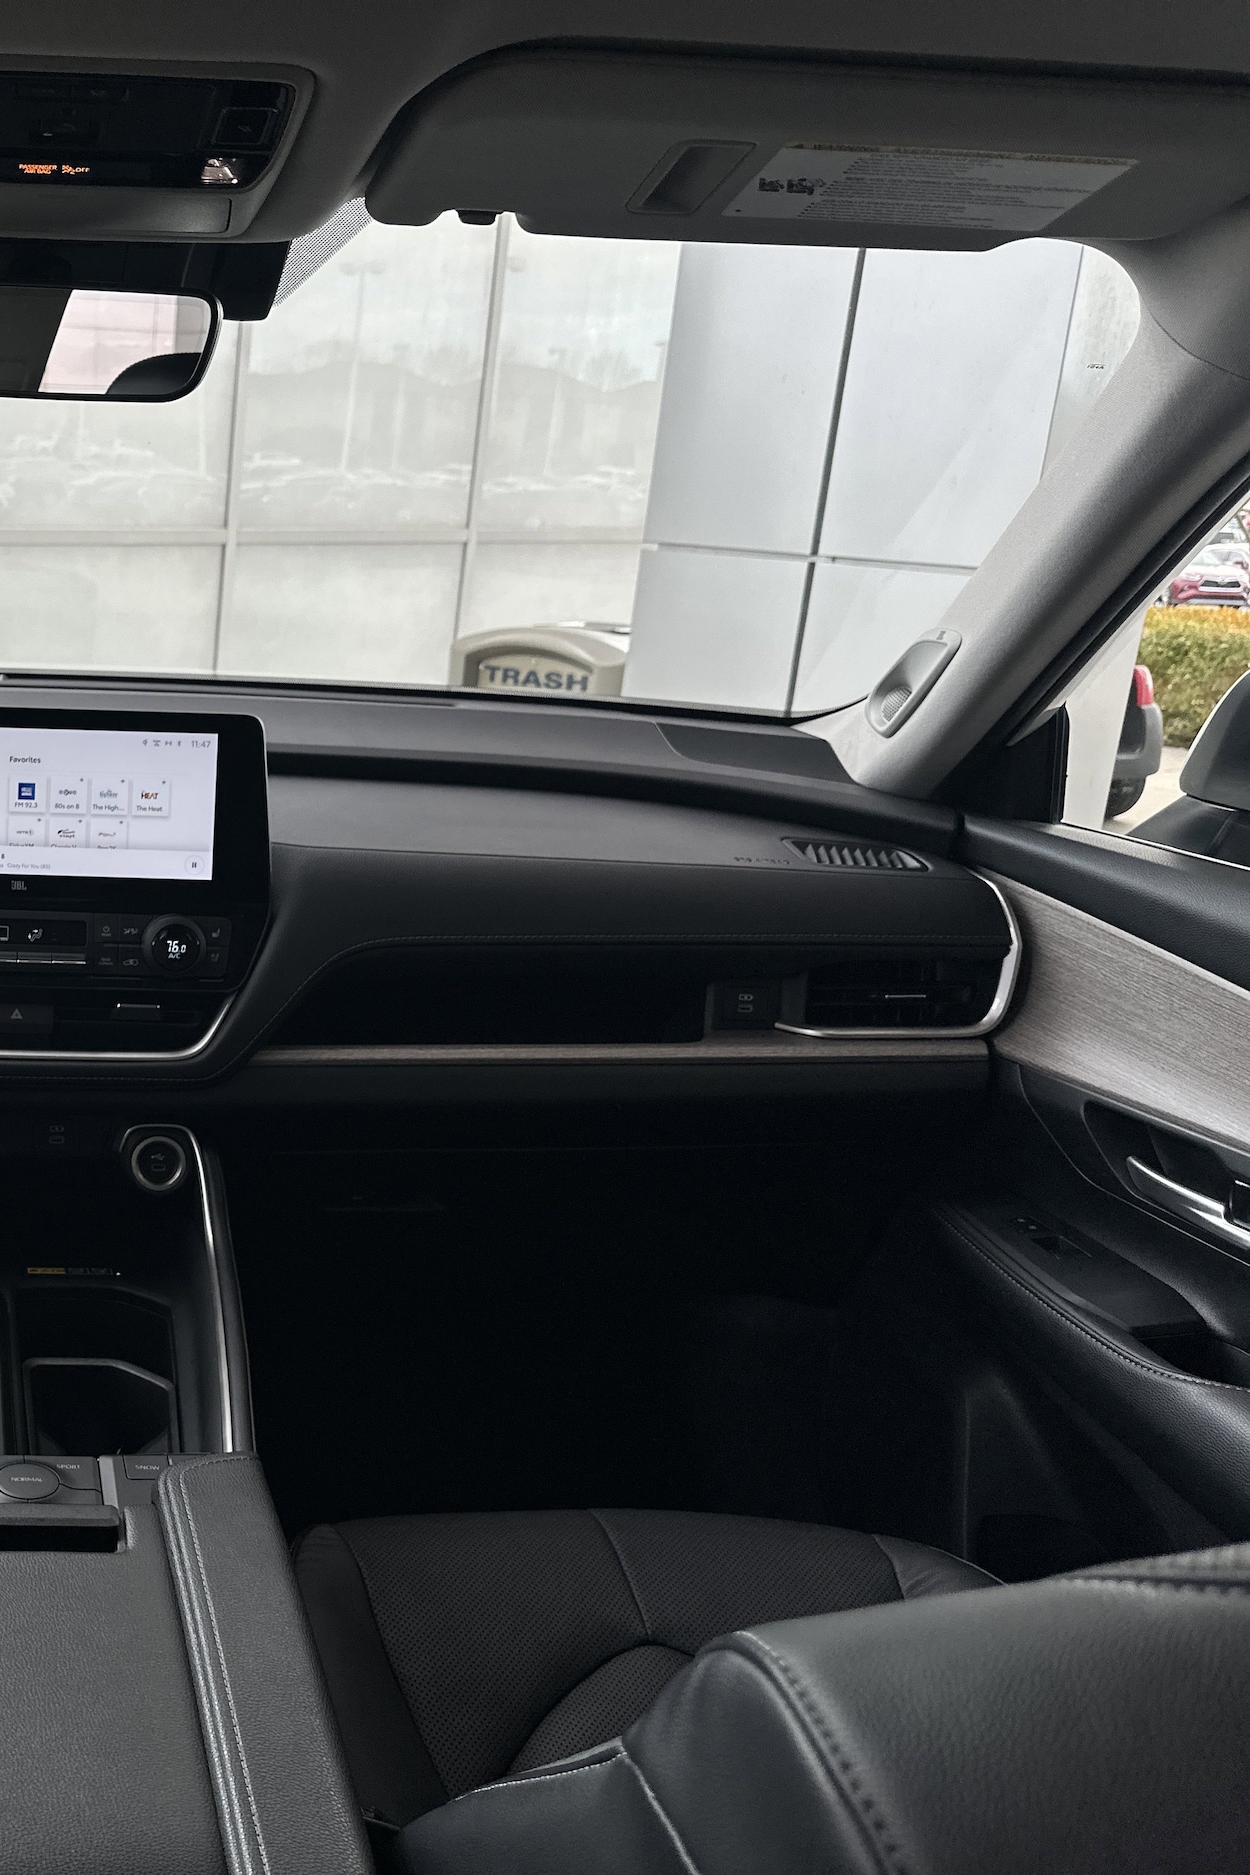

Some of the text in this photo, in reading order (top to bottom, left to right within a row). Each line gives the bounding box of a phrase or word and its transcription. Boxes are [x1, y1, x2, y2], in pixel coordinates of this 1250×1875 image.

[18, 163, 58, 171] PASSENGER
[484, 665, 589, 692] TRASH
[191, 740, 211, 748] 11:47
[9, 755, 42, 764] Favorites
[92, 803, 104, 811] The
[11, 880, 28, 890] JBL
[166, 940, 187, 953] 76.0
[168, 952, 181, 960] A/C
